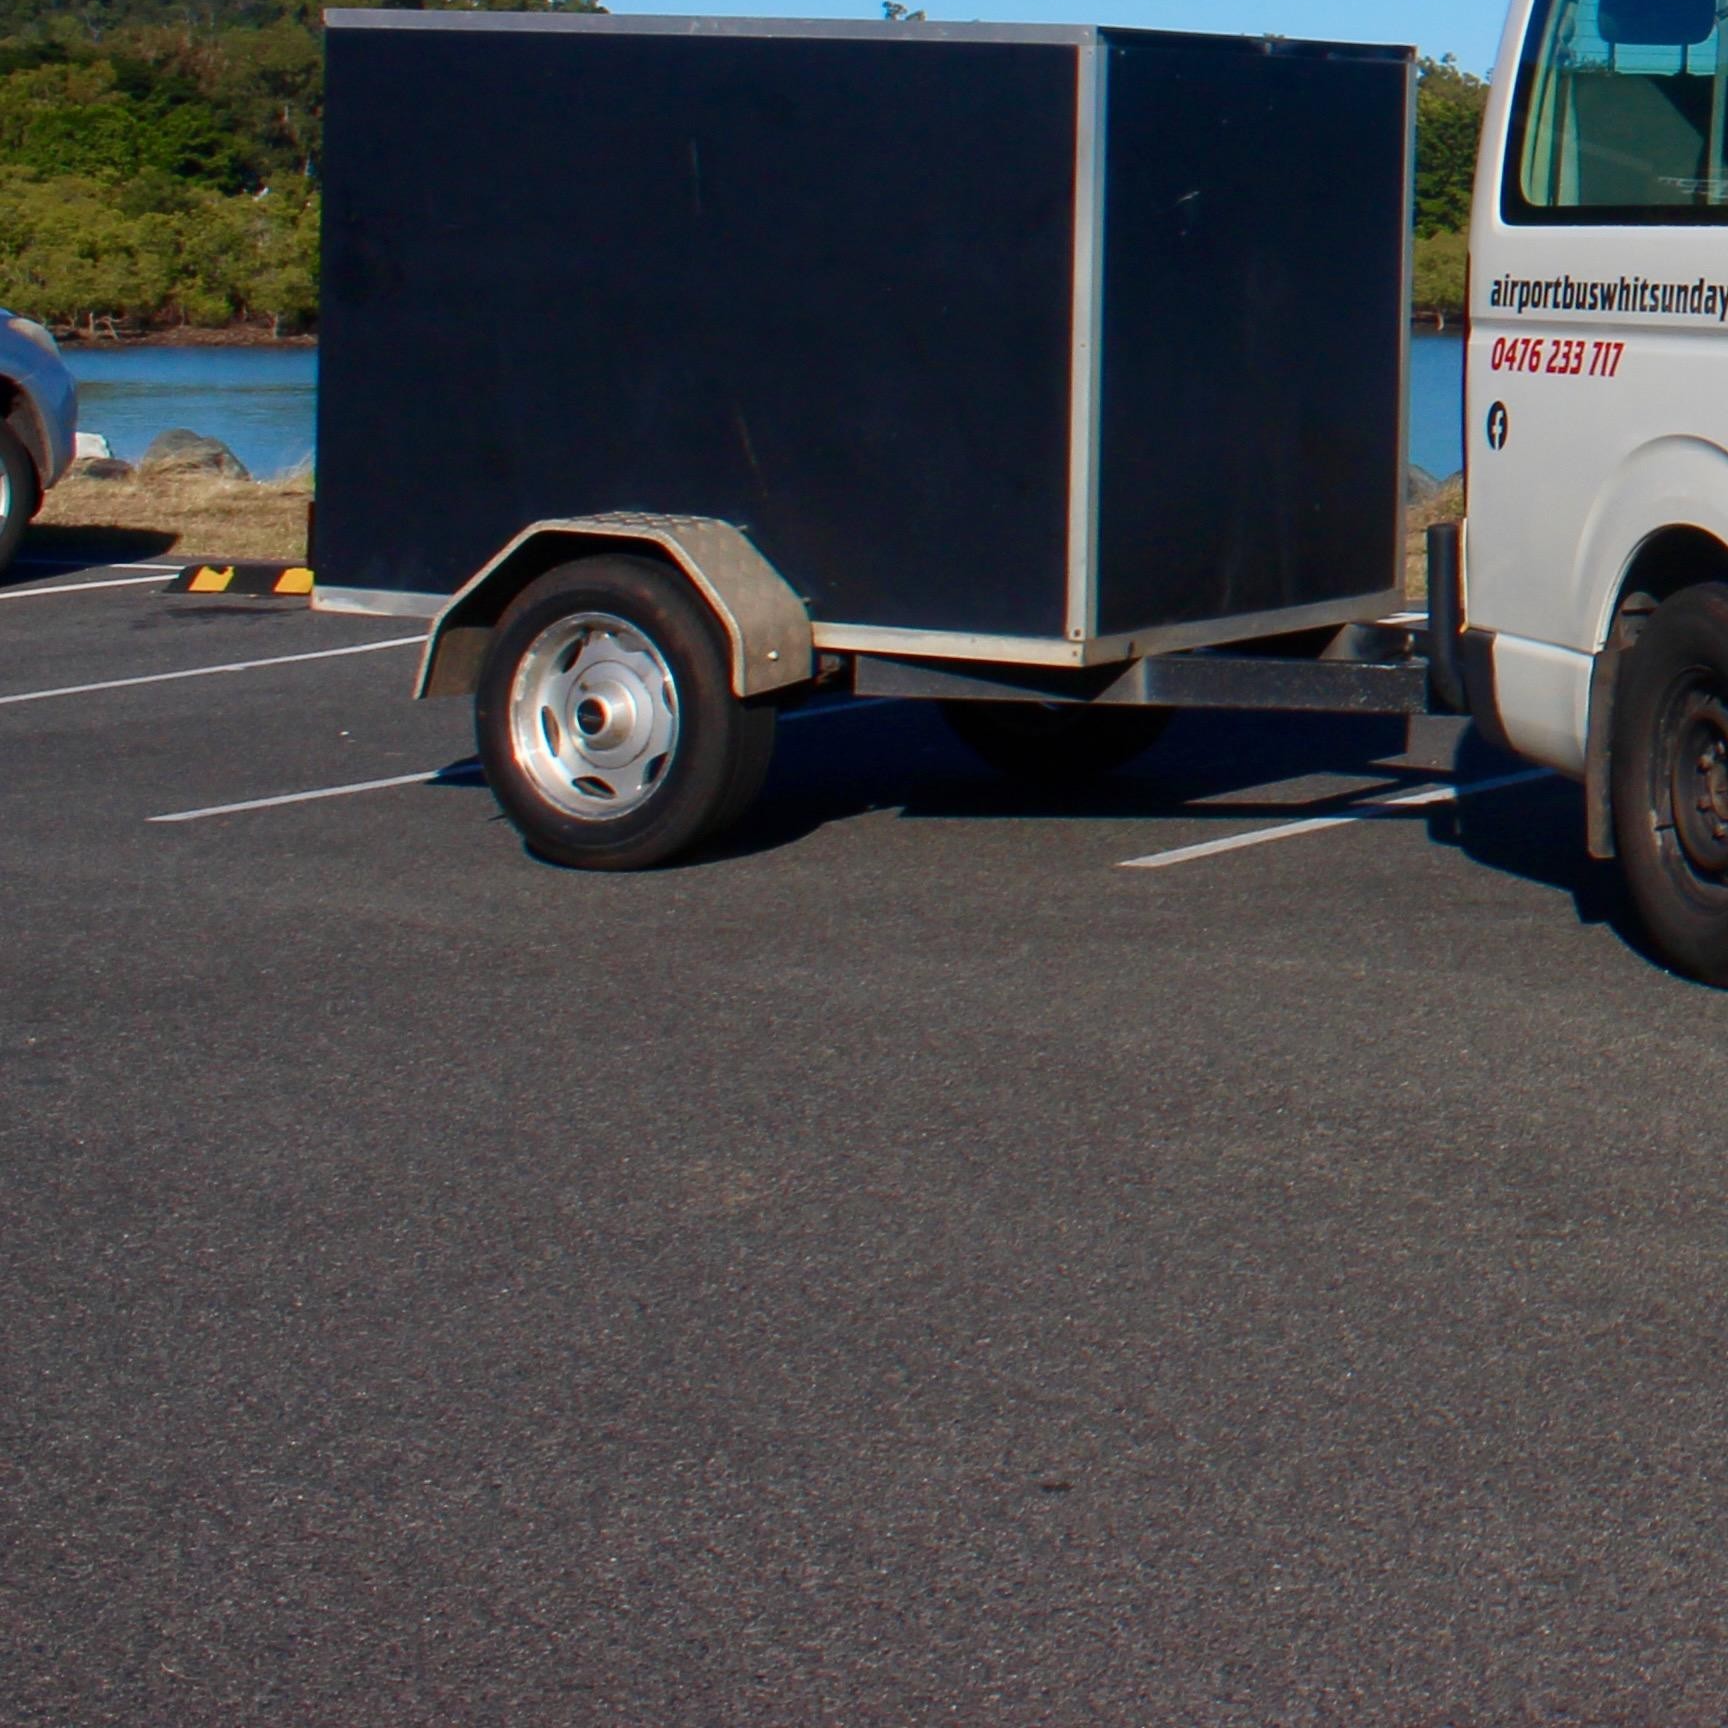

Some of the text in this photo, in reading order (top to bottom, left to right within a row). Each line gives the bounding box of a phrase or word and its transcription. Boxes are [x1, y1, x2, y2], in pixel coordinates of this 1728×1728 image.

[1491, 337, 1624, 377] 0476 233 717
